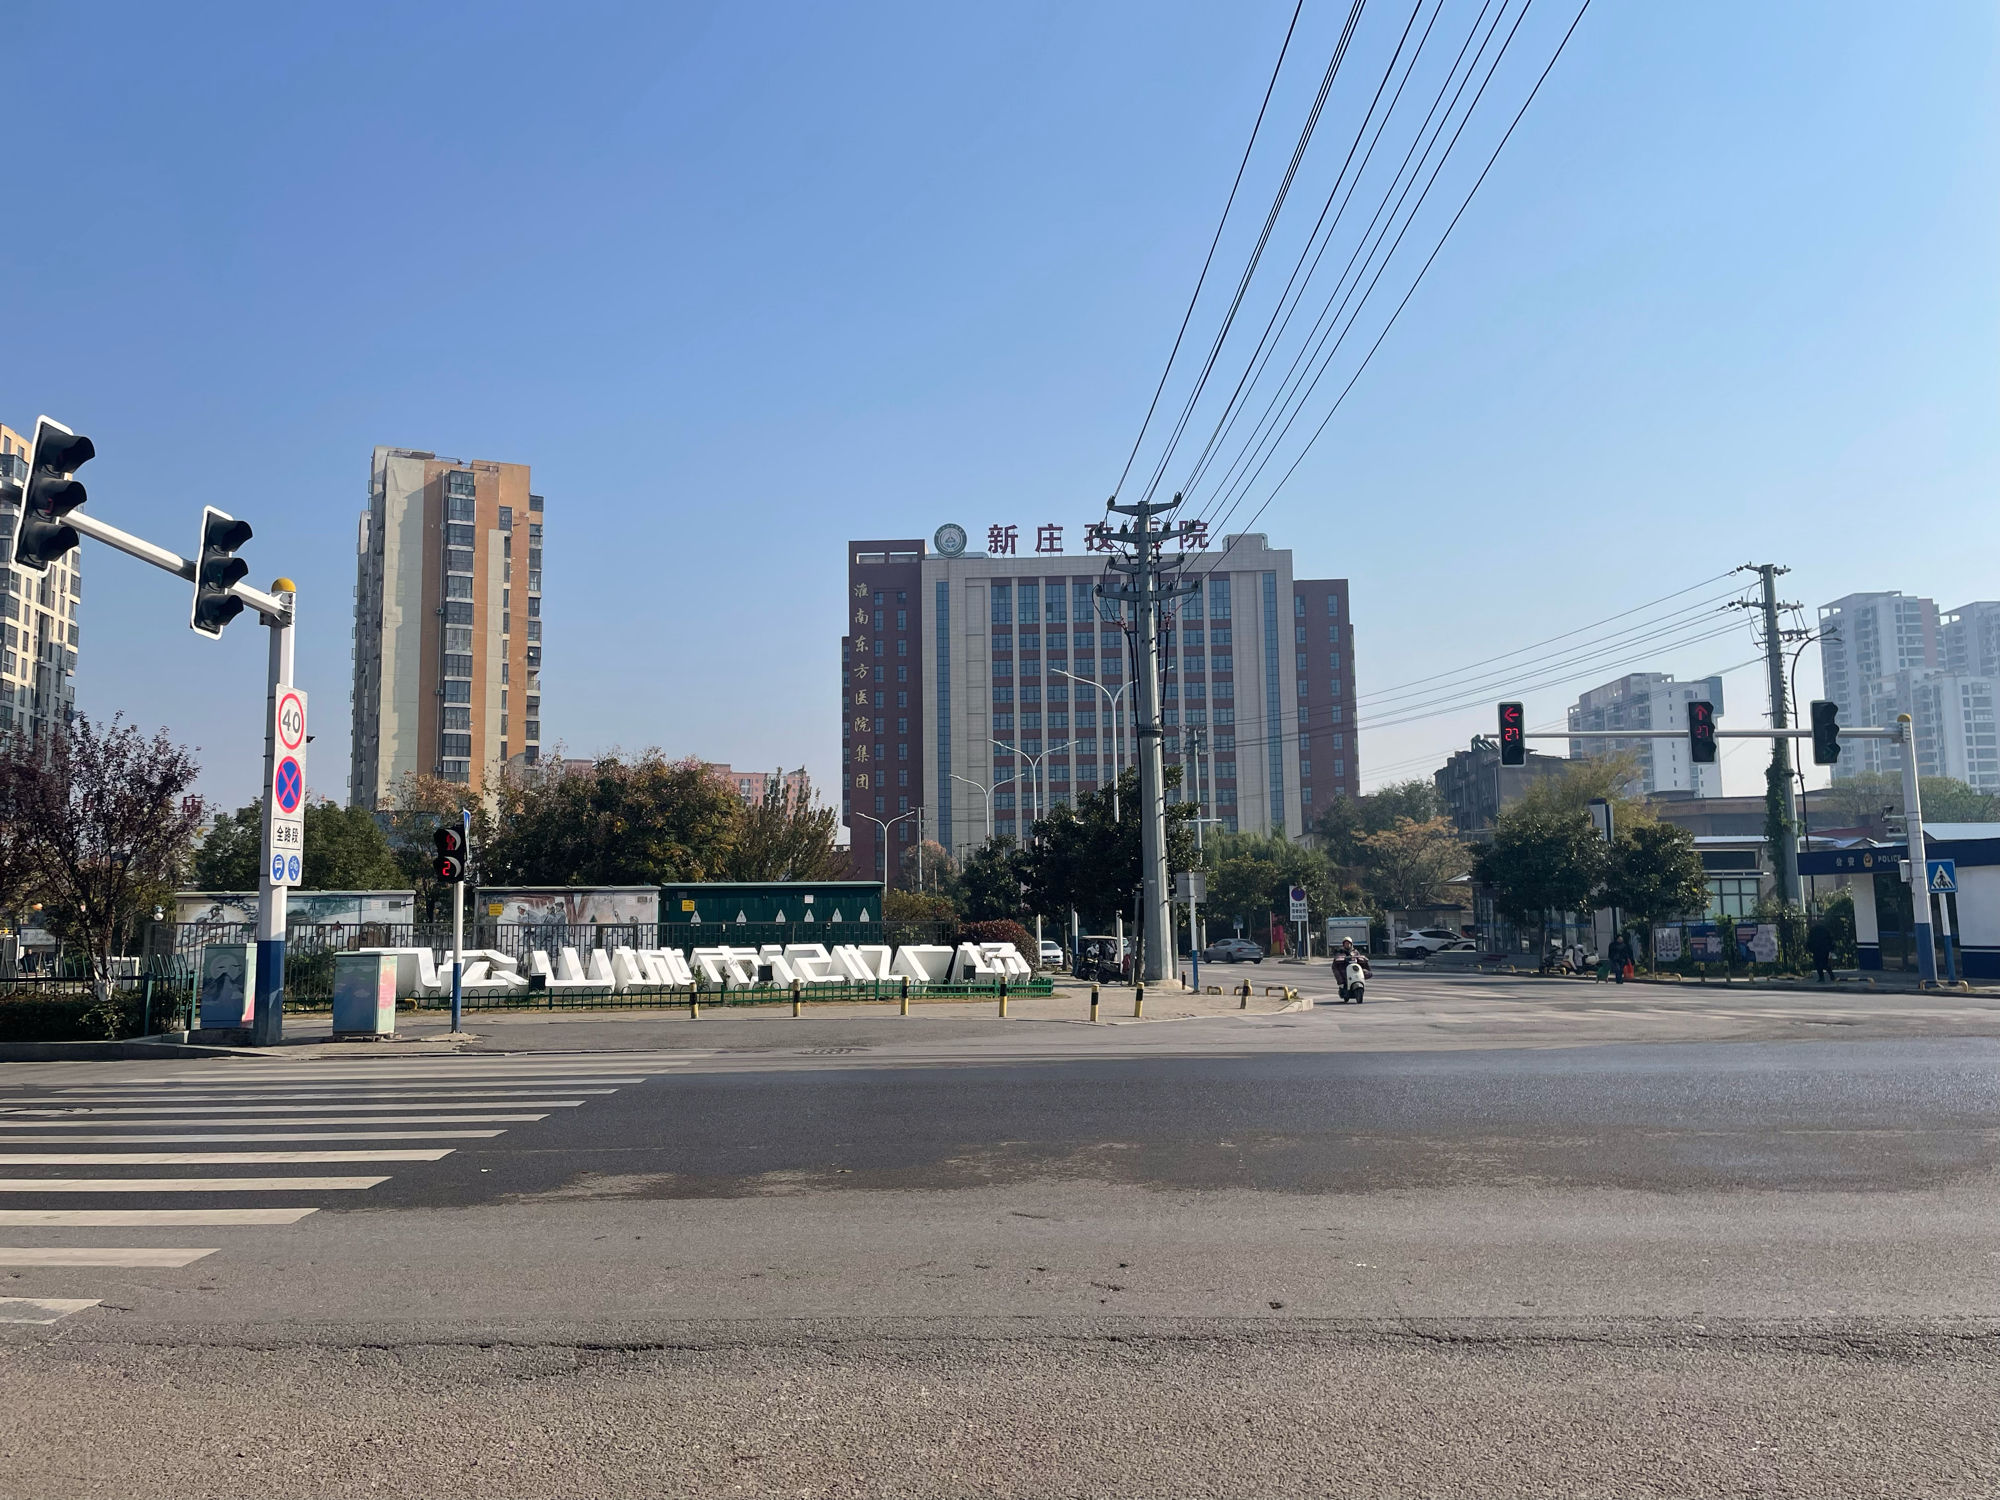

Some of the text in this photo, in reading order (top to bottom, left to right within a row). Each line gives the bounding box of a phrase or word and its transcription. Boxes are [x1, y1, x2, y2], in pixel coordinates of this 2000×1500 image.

[853, 583, 871, 790] 淮南东方医院集团
[282, 709, 300, 733] 40
[1504, 727, 1519, 741] 27
[276, 825, 299, 844] 全路段
[1836, 856, 1855, 867] 公安
